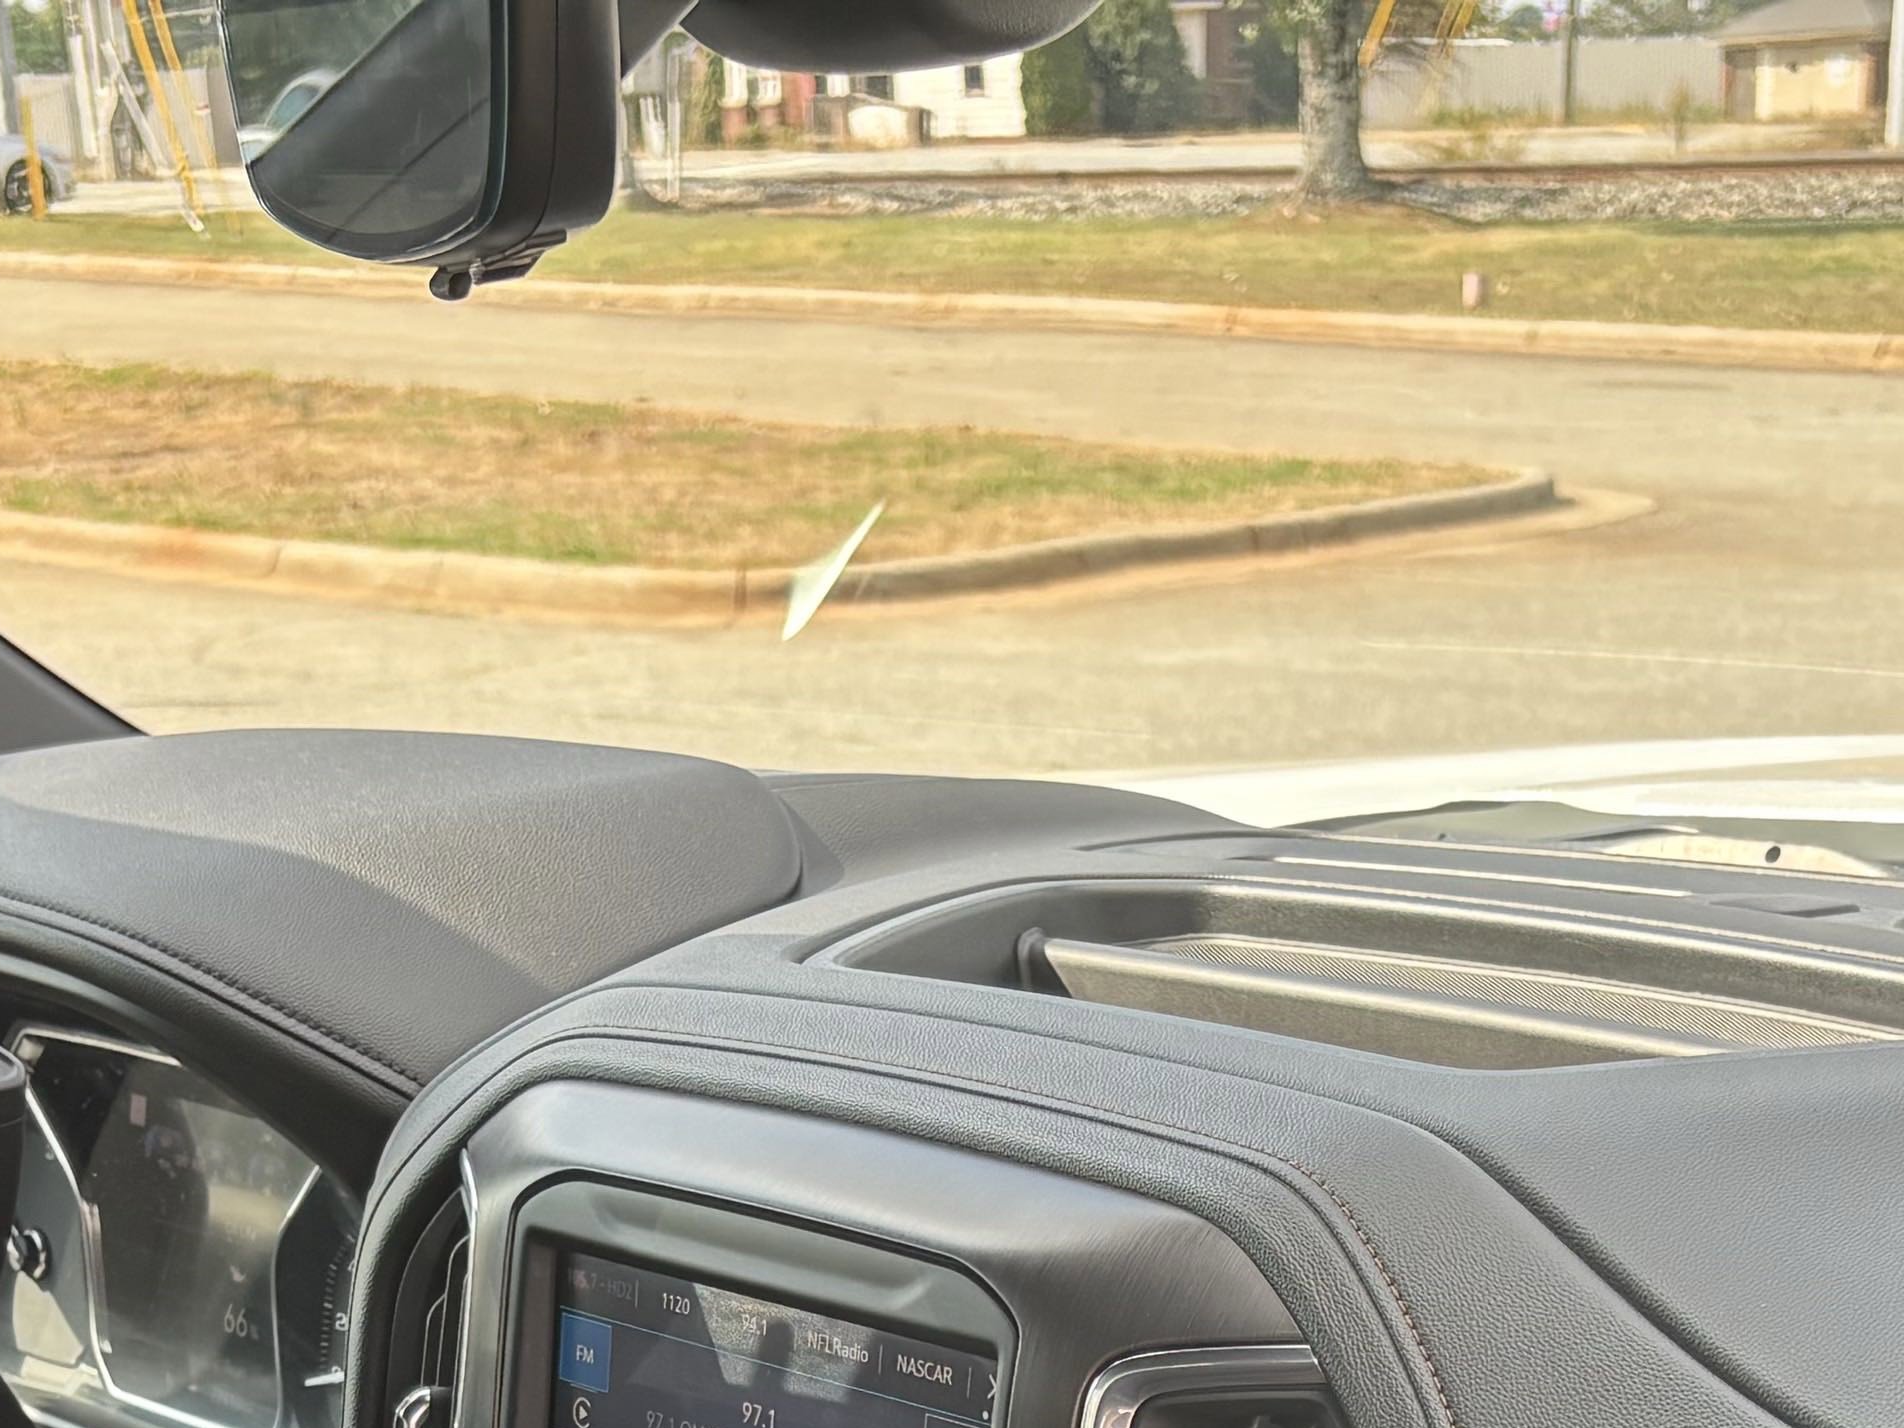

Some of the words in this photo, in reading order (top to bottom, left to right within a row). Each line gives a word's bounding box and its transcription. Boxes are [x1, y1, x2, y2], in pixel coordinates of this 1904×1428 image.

[662, 1292, 691, 1315] 1120
[575, 1344, 594, 1365] FM
[896, 1354, 953, 1386] NASCAR
